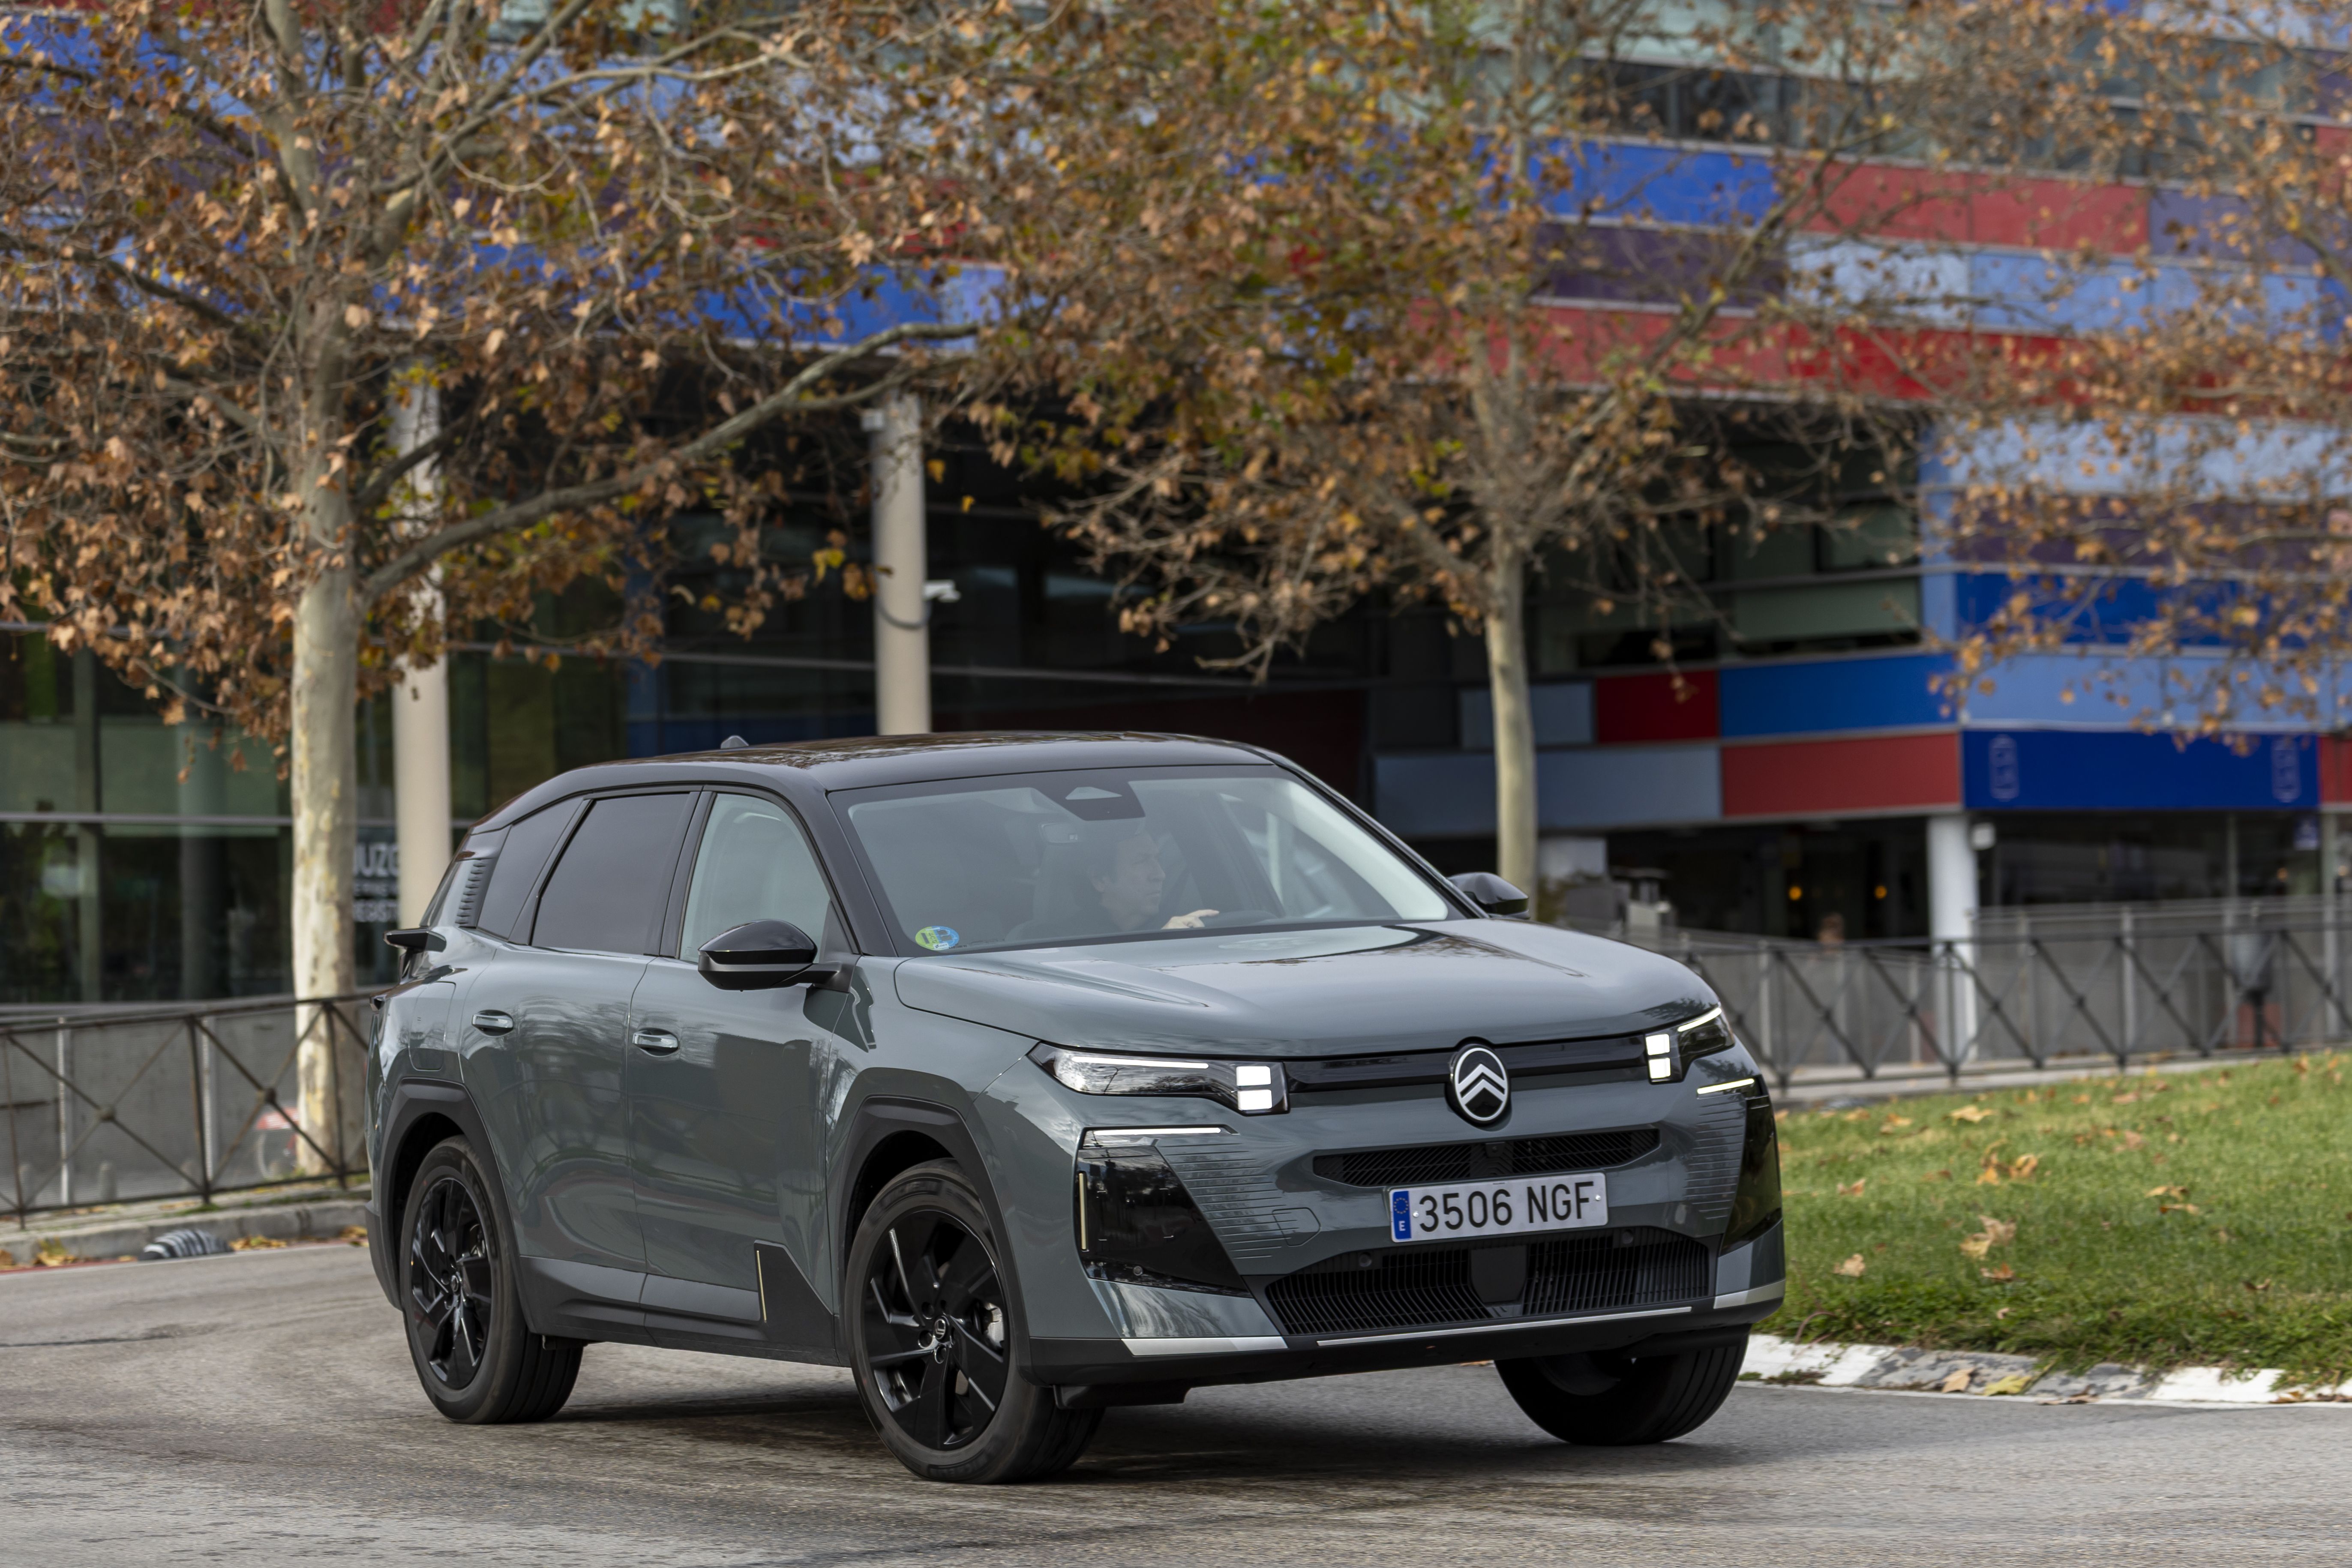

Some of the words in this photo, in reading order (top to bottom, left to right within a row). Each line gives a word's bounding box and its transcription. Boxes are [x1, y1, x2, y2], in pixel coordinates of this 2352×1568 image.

[1419, 1189, 1512, 1232] 3506
[1527, 1181, 1594, 1223] NGF
[1398, 1220, 1406, 1231] E
